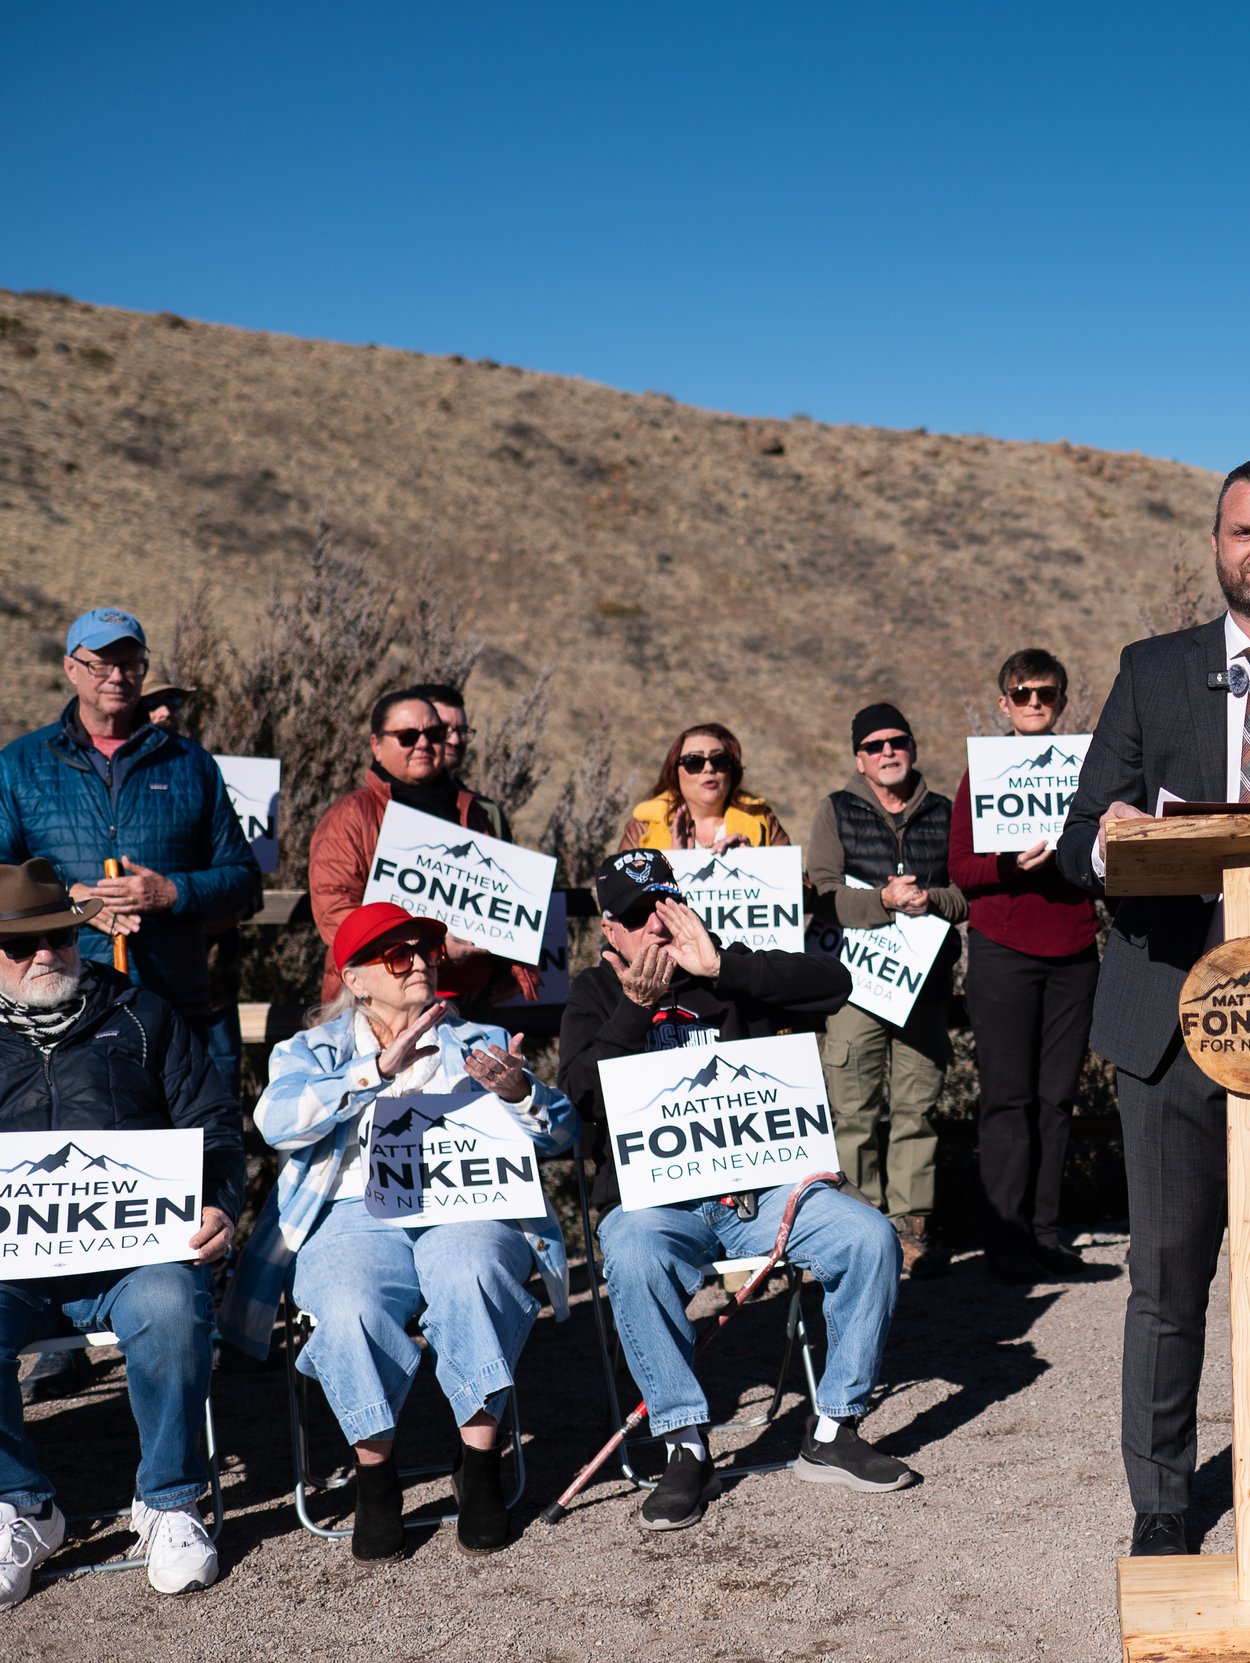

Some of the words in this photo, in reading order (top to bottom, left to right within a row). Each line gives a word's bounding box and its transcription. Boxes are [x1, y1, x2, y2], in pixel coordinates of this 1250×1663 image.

[1008, 775, 1079, 789] MATTHE
[996, 823, 1032, 835] FOR
[416, 854, 509, 894] MATTHEW
[372, 857, 543, 932] FONKEN
[684, 888, 761, 902] ATTHEW
[390, 894, 428, 917] FOR
[435, 909, 515, 943] NEVADA
[1200, 1039, 1236, 1053] FOR
[661, 1088, 778, 1119] MATTHEW
[372, 1139, 477, 1158] ATTHEW
[616, 1104, 830, 1166] FONKEN
[370, 1155, 534, 1190] NKEN
[651, 1161, 701, 1183] FOR
[712, 1145, 809, 1172] NEVADA
[0, 1195, 196, 1235] NKEN
[397, 1191, 508, 1209] NEVADA
[34, 1233, 160, 1256] NEVADA
